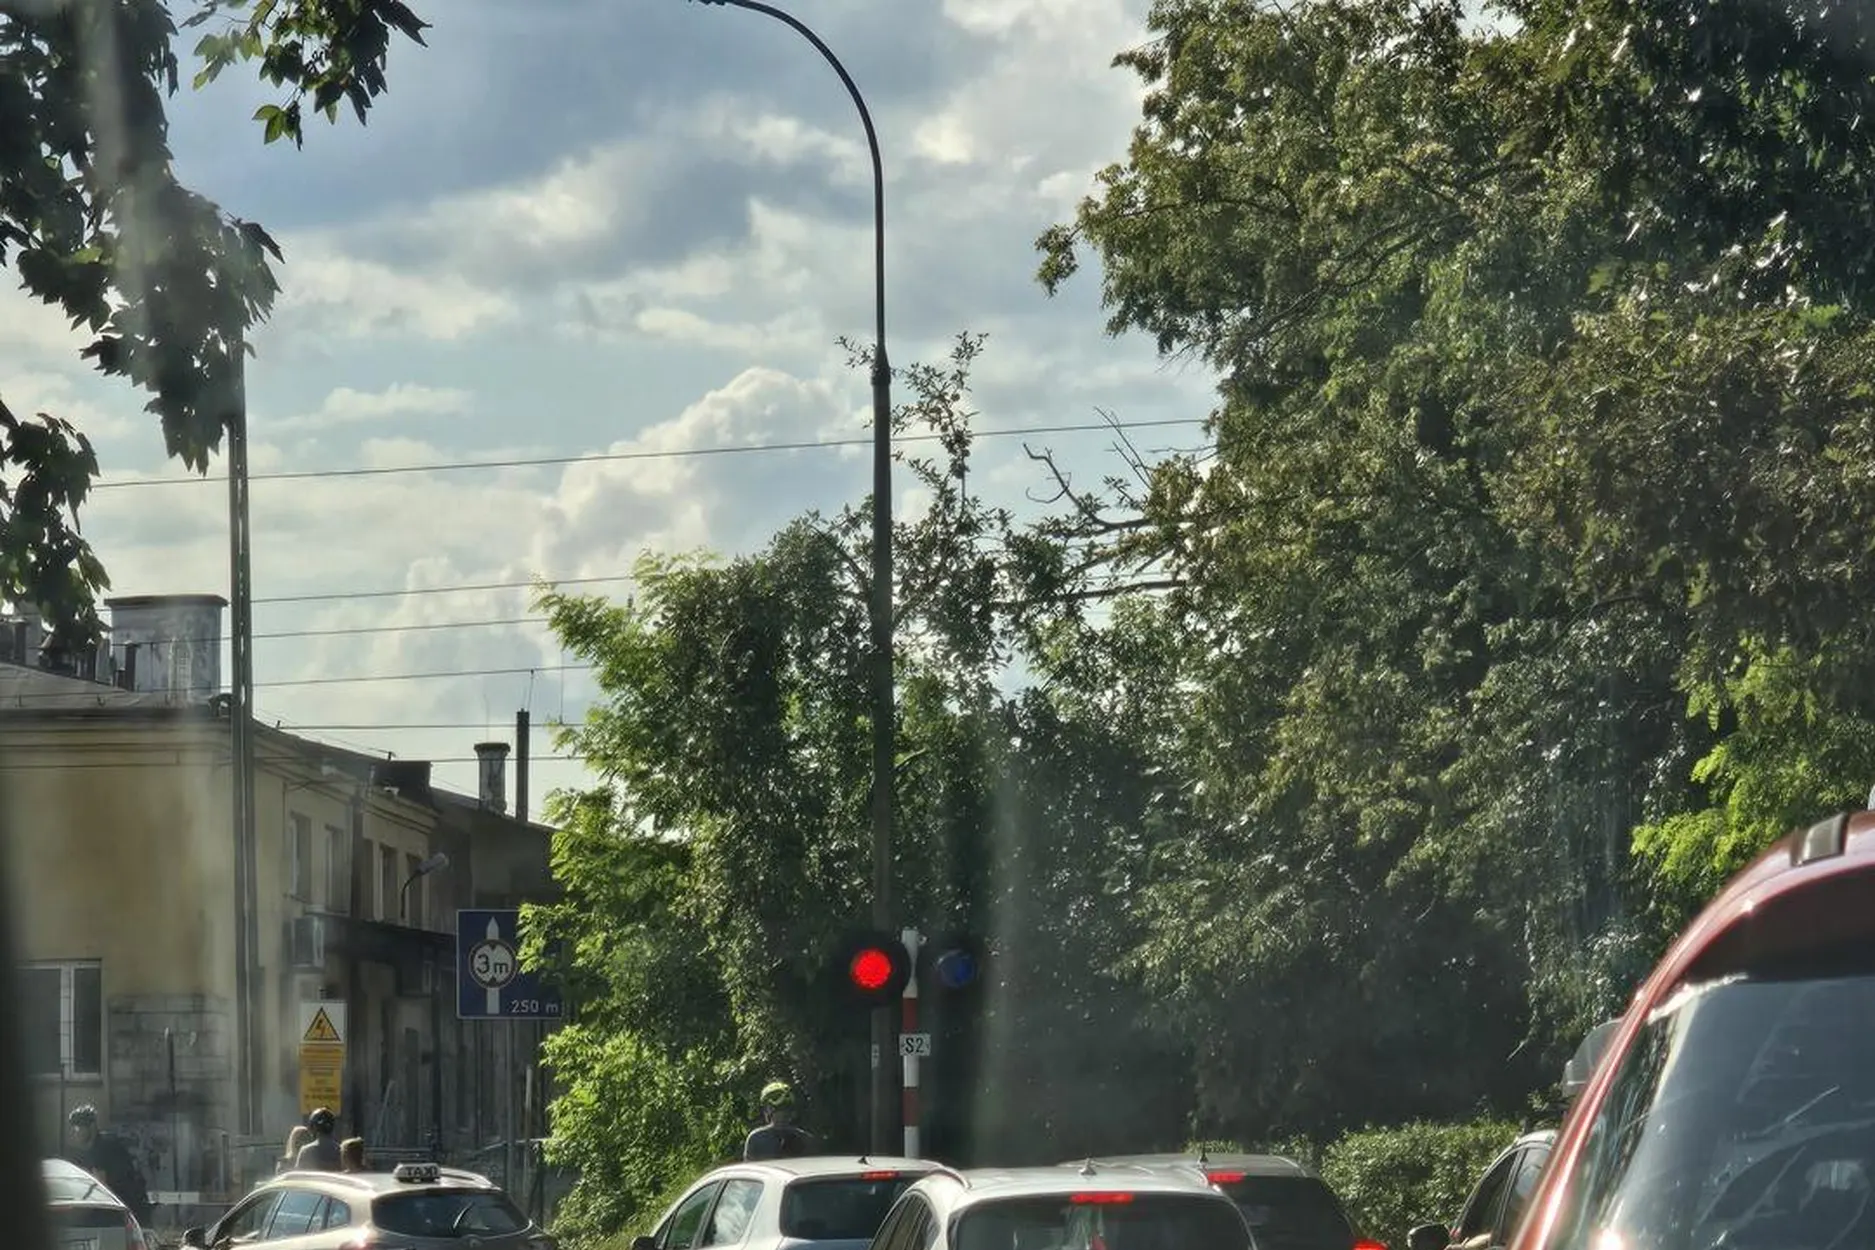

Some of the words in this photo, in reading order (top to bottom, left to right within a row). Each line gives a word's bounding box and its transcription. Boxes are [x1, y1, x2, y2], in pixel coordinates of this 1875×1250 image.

[511, 999, 539, 1013] 250
[545, 1002, 559, 1013] m
[905, 1037, 924, 1054] S2
[406, 1165, 437, 1177] TAXI
